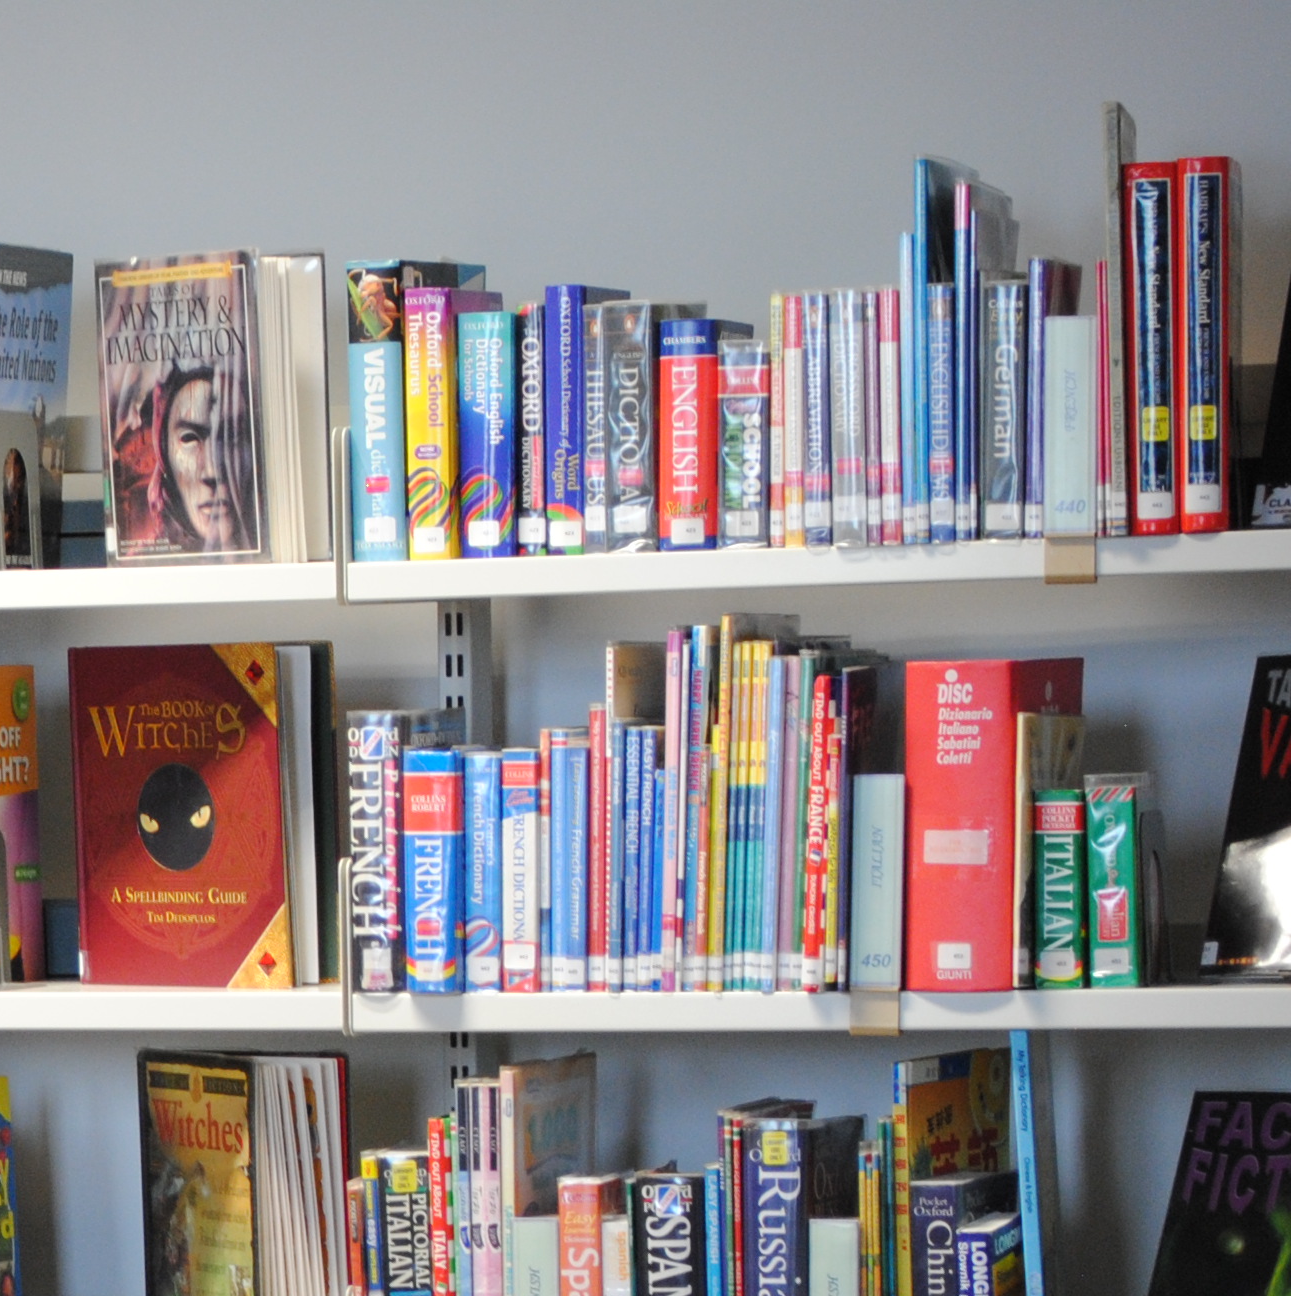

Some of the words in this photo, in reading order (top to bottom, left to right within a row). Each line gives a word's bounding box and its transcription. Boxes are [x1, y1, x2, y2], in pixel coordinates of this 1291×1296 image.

[1198, 240, 1211, 265] New
[118, 297, 210, 332] MYSTERY
[217, 294, 234, 324] &
[1197, 268, 1211, 323] Standard
[9, 307, 28, 338] Role
[32, 308, 43, 347] of
[44, 313, 58, 342] the
[106, 326, 248, 365] IMAGINATION
[425, 311, 442, 367] Oxford
[464, 338, 474, 355] for
[663, 335, 707, 347] CHAMBERS
[21, 357, 57, 384] Nations
[408, 312, 423, 395] Thesaurus
[488, 337, 504, 387] Oxford
[463, 357, 474, 401] Schools
[471, 338, 488, 414] Dictionary
[521, 336, 541, 432] OXFORD
[931, 343, 950, 428] ENGLISH
[363, 348, 386, 449] VISUAL
[427, 374, 444, 427] School
[993, 344, 1019, 458] German
[485, 393, 505, 444] English
[671, 363, 698, 494] ENGLISH
[521, 436, 533, 509] DICTIONARY
[552, 449, 567, 499] Origins
[567, 453, 580, 490] Word
[741, 412, 761, 509] SCHOOL
[1054, 500, 1087, 514] 440
[691, 669, 702, 705] HARRY
[814, 692, 825, 718] FIND
[690, 708, 702, 746] LEARNS
[813, 722, 824, 743] OUT
[937, 707, 993, 722] Dizionario
[937, 722, 980, 736] Italiano
[0, 725, 22, 748] OFF
[642, 738, 654, 770] EASY
[936, 737, 981, 751] Sabatini
[626, 736, 640, 802] ESSENTIAL
[689, 751, 701, 791] FRENCH
[812, 746, 824, 780] ABOUT
[936, 751, 972, 765] Coletti
[410, 794, 446, 804] COLLINS
[411, 802, 446, 812] ROBERT
[472, 781, 486, 832] French
[641, 773, 654, 826] FRENCH
[808, 785, 826, 844] FRANCE
[1042, 806, 1076, 815] COLLINS
[1042, 814, 1076, 823] POCKET
[349, 761, 386, 939] FRENCH
[626, 809, 639, 854] FRENCH
[383, 766, 402, 938] Pictorial
[466, 835, 485, 905] Dictionary
[571, 829, 583, 874] French
[111, 887, 122, 904] A
[125, 887, 204, 904] SPELLBINDING
[207, 887, 248, 905] GUIDE
[569, 876, 583, 939] Grammar
[1042, 833, 1074, 952] ITALIAN
[145, 911, 163, 924] TIM
[861, 953, 892, 968] 450
[936, 969, 972, 981] GIUNTI
[153, 1098, 245, 1154] Witches
[431, 1132, 441, 1159] FIND
[432, 1162, 442, 1182] OUT
[708, 1174, 717, 1206] EASY
[433, 1185, 444, 1218] ABOUT
[564, 1211, 597, 1225] Easy
[913, 1206, 955, 1217] Oxford
[918, 1197, 948, 1208] Pocket
[367, 1218, 379, 1247] easy
[387, 1193, 414, 1289] ITALIAN
[411, 1192, 432, 1289] PICTORIAL
[433, 1229, 447, 1270] ITALY
[709, 1209, 719, 1264] SPANISH
[616, 1231, 629, 1281] spanish
